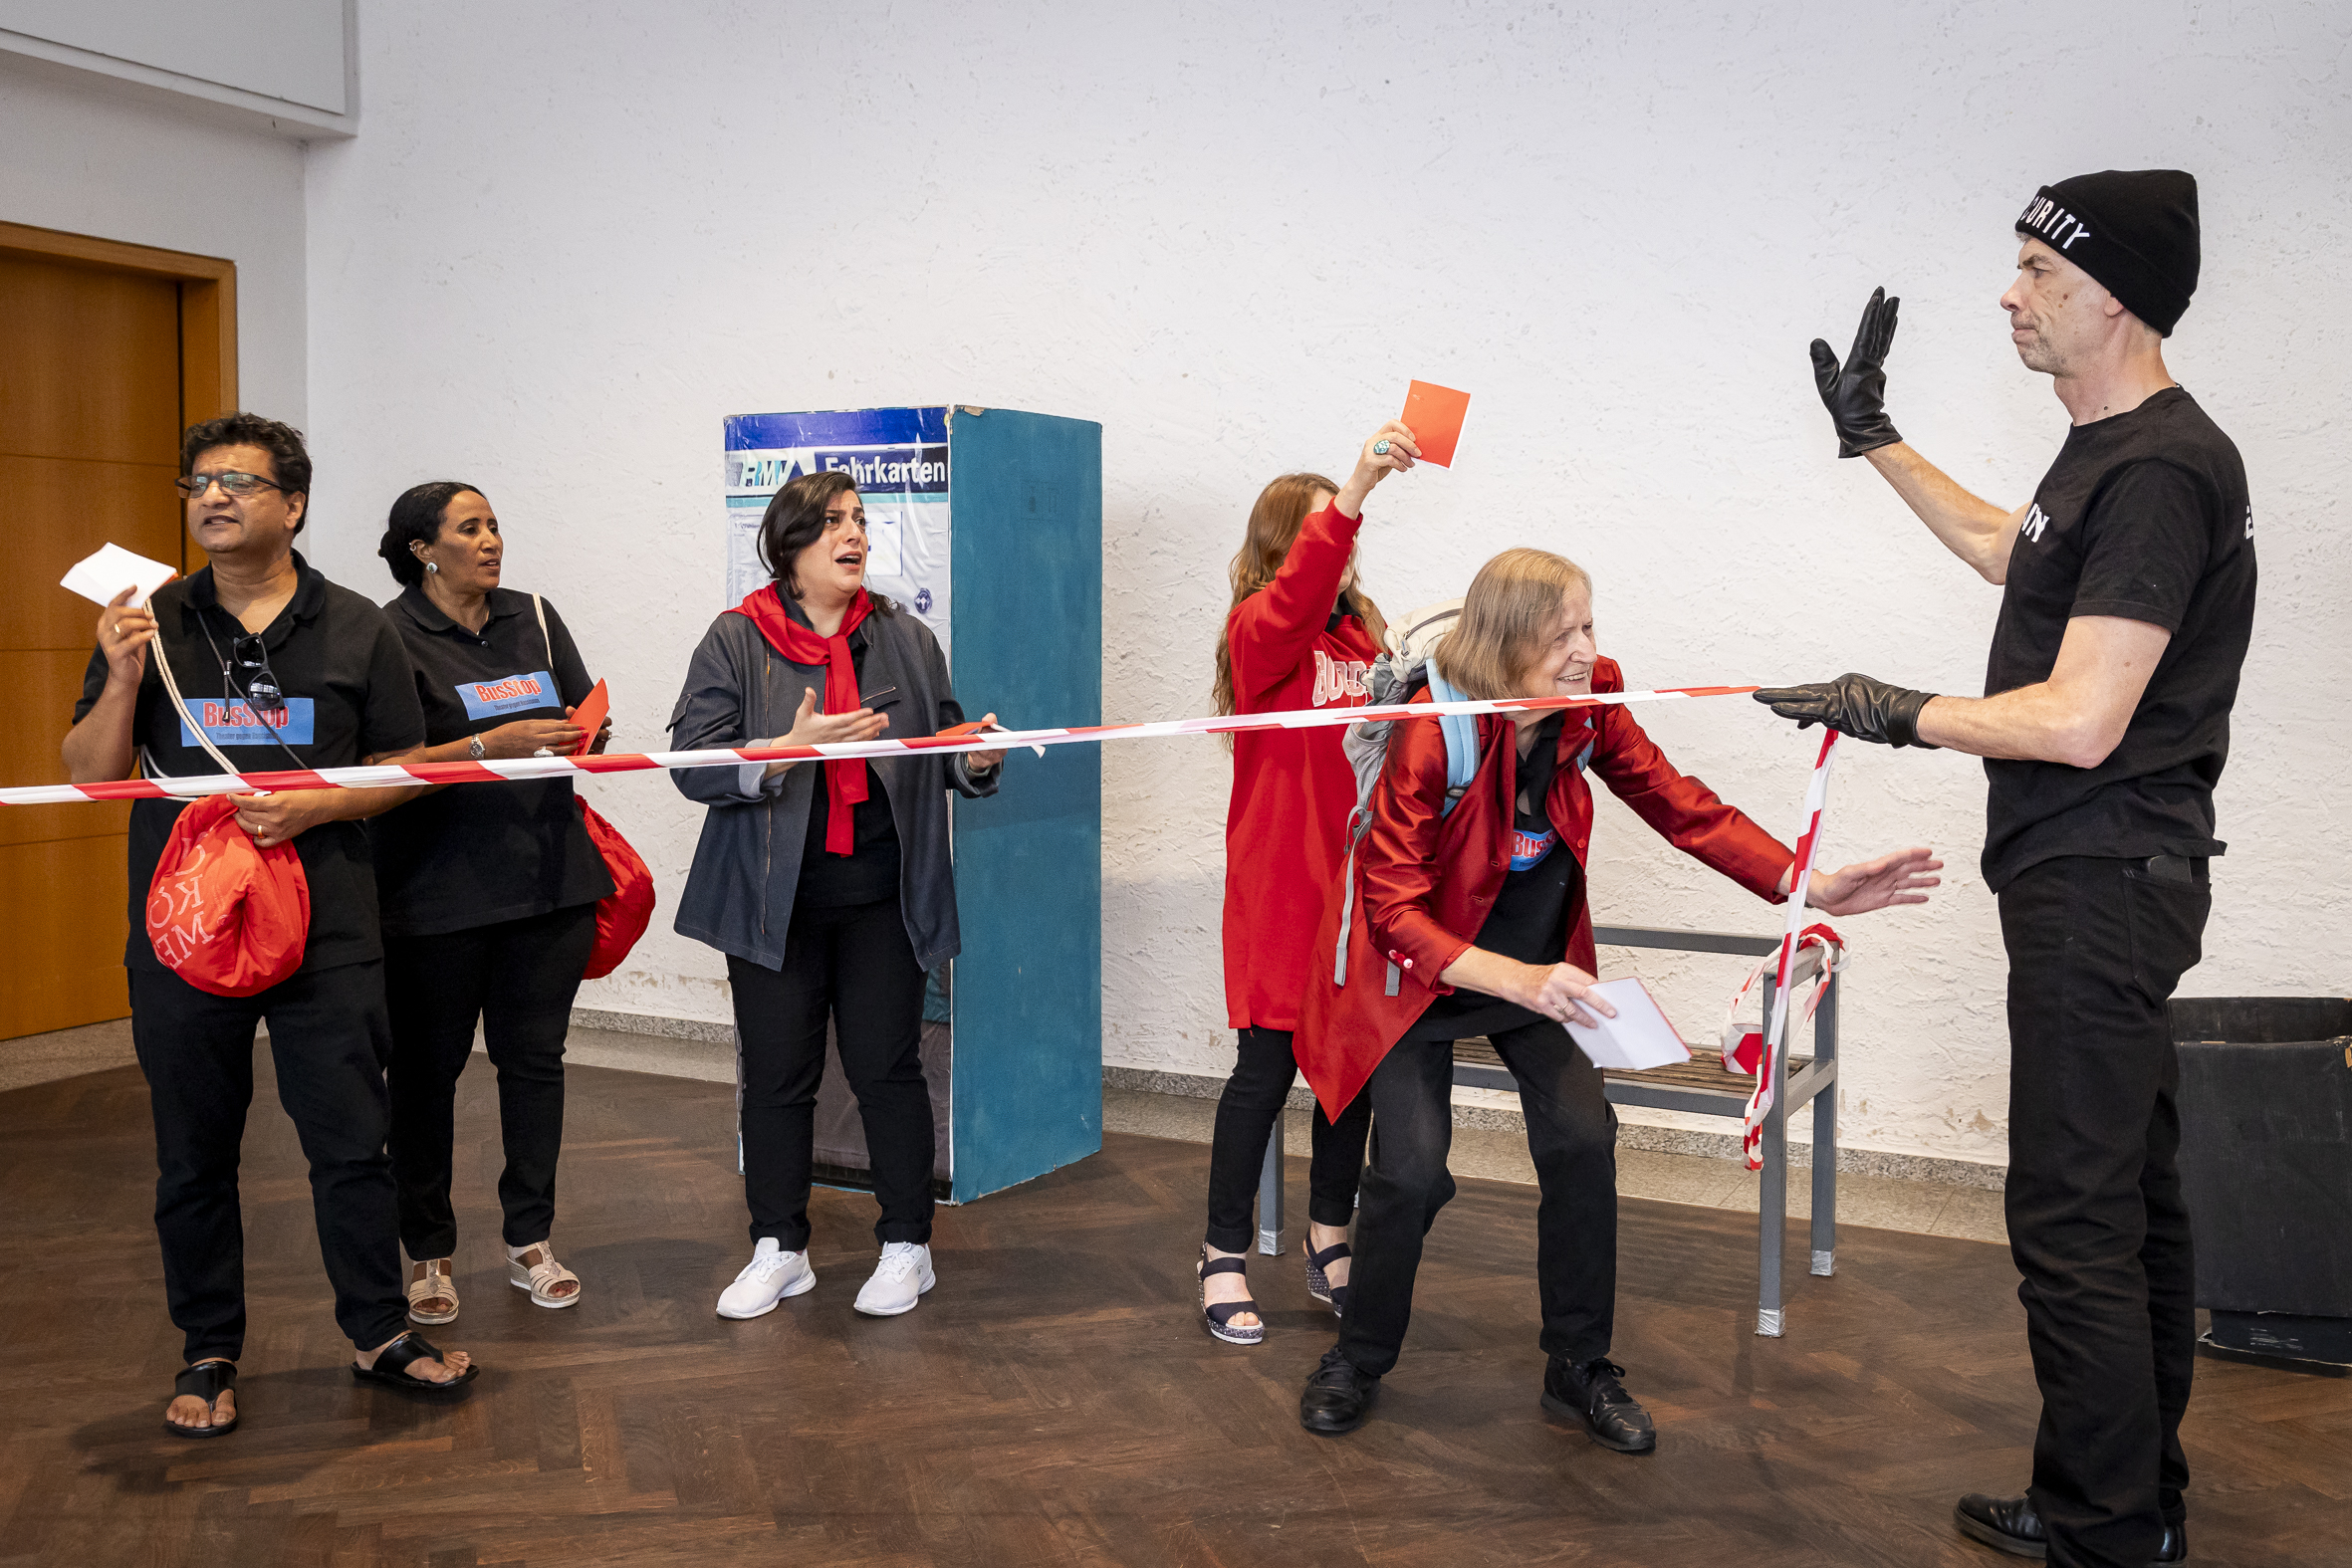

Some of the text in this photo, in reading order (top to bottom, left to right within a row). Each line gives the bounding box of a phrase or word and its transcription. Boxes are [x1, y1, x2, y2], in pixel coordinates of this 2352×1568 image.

[2020, 195, 2090, 250] CURITY
[474, 679, 542, 703] BusStop
[153, 910, 215, 970] WE
